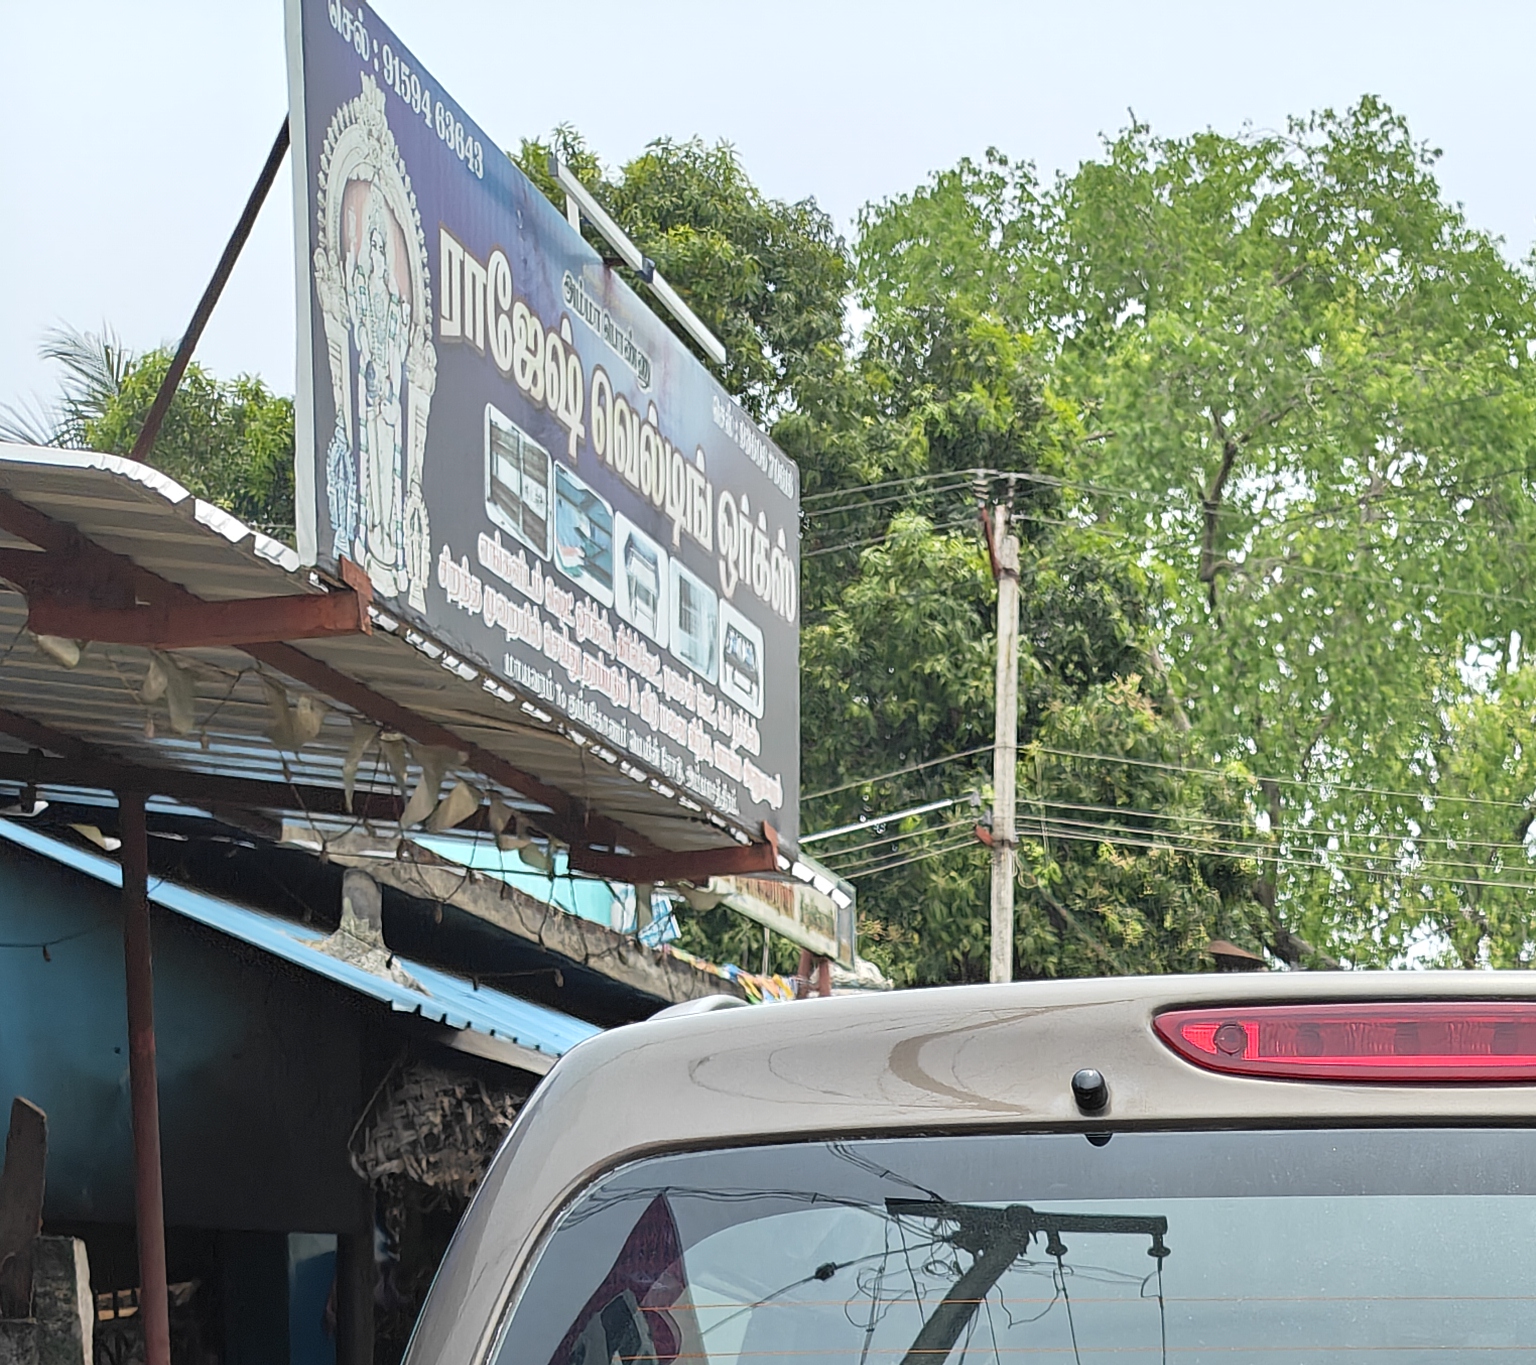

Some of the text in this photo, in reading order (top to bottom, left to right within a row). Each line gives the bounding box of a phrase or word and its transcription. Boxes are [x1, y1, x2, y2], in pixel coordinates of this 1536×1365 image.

[382, 44, 432, 128] 91594
[434, 102, 484, 180] 63643
[439, 226, 796, 623] ராஜேஷ் வெல்டிங் ஒர்க்ஸ்
[438, 546, 481, 615] சிறந்த
[483, 583, 542, 652] முறையில்
[542, 617, 582, 685] செய்து
